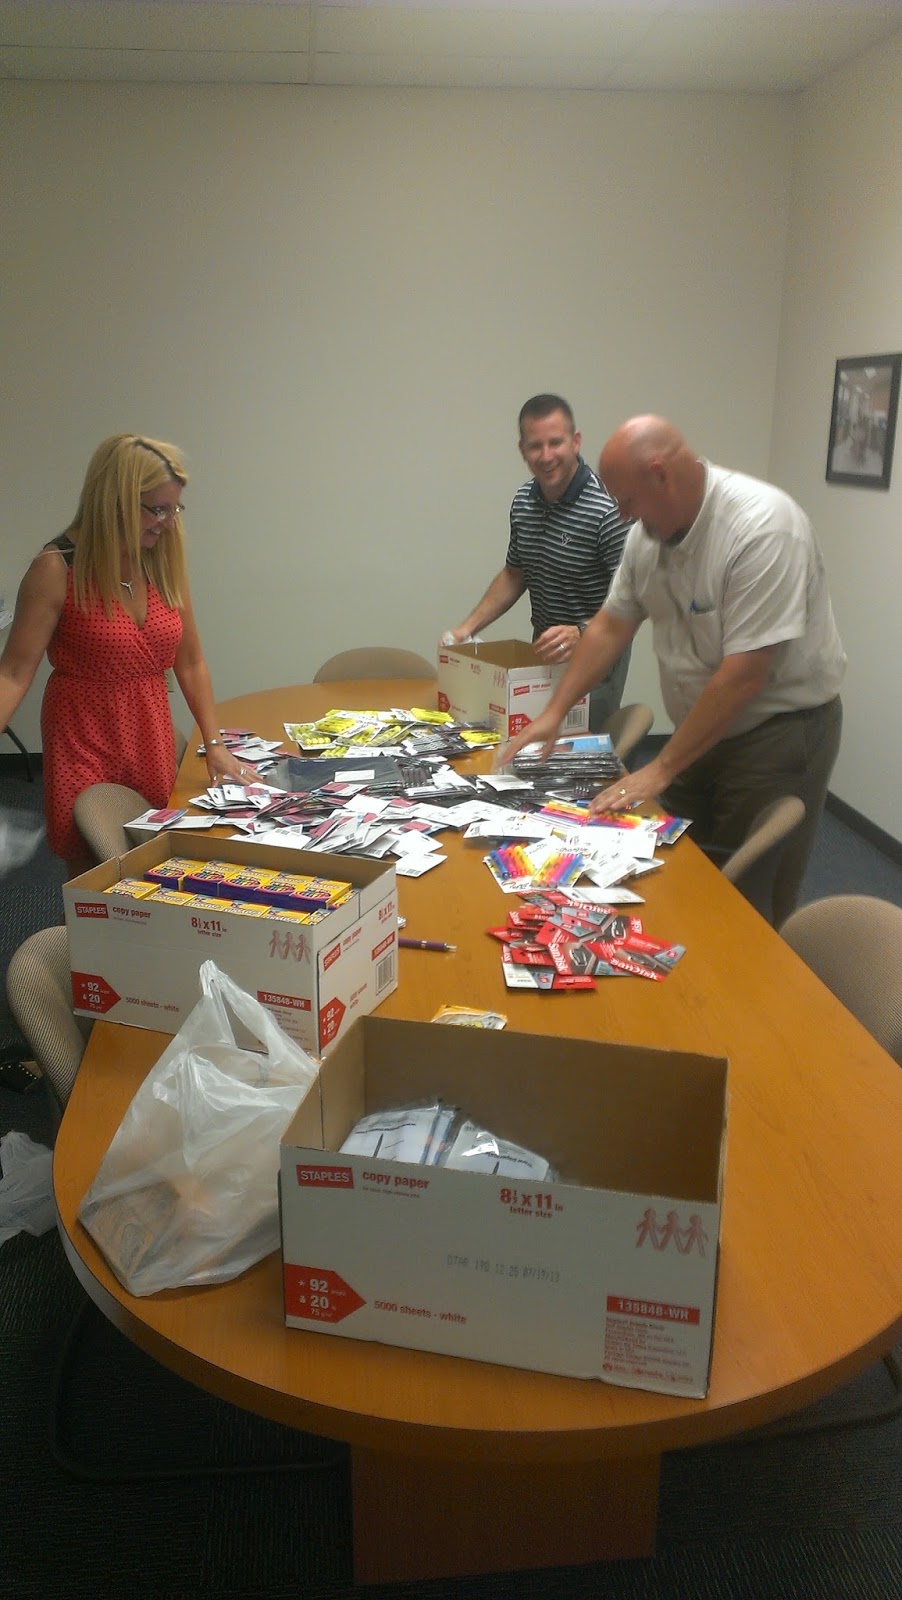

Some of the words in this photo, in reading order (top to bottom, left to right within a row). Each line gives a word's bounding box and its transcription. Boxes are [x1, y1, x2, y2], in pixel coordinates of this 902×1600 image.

[77, 905, 107, 915] STAPLES
[112, 906, 130, 917] copy
[131, 908, 152, 919] paper
[87, 981, 99, 993] 92
[88, 993, 101, 1004] 20
[125, 996, 140, 1005] 5000
[140, 998, 159, 1009] sheets
[163, 1004, 180, 1013] white
[263, 993, 305, 1008] 135848-WH
[300, 1170, 350, 1183] STAPLES
[362, 1170, 391, 1186] copy
[394, 1175, 430, 1190] paper
[510, 1205, 532, 1216] letter
[535, 1210, 553, 1219] size
[309, 1278, 329, 1293] 92
[310, 1294, 329, 1310] 20
[373, 1300, 398, 1313] 5000
[399, 1304, 431, 1319] sheets
[439, 1311, 468, 1325] white
